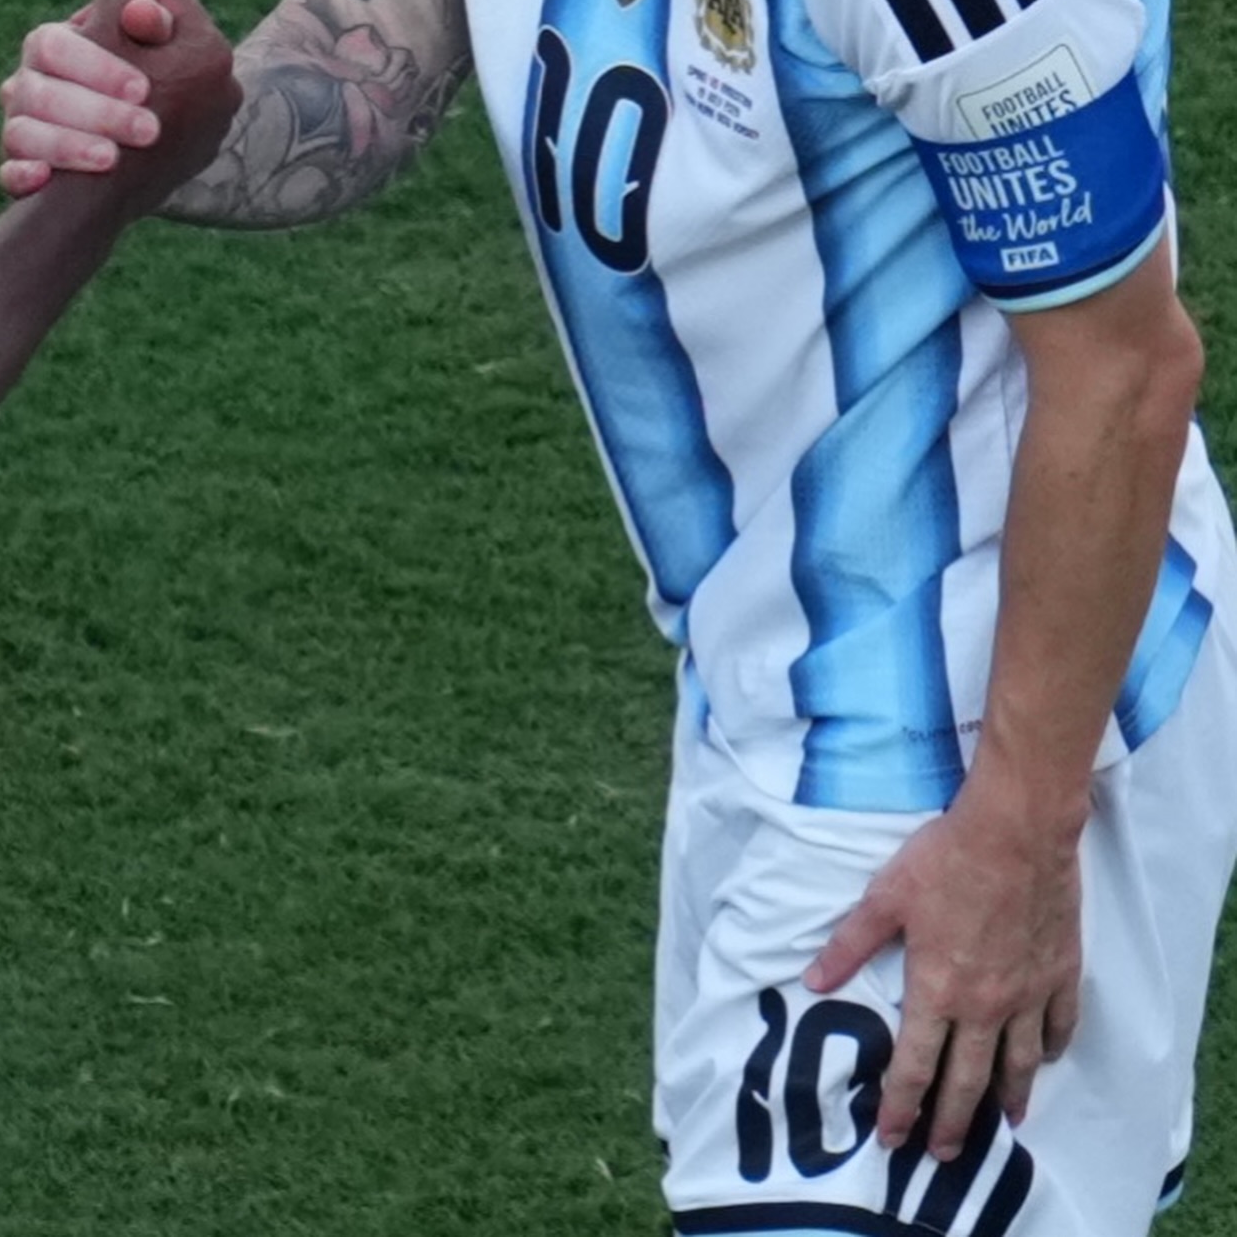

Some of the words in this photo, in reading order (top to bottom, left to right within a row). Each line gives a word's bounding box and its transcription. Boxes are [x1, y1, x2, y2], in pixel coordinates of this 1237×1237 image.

[981, 71, 1066, 121] FOOTBALL
[534, 25, 670, 275] 10
[937, 135, 1065, 176] FOOTBALL
[948, 159, 1077, 211] UNITES
[958, 212, 1002, 242] the
[1002, 191, 1093, 241] World
[1006, 247, 1055, 267] FIFA
[736, 986, 893, 1184] 10
